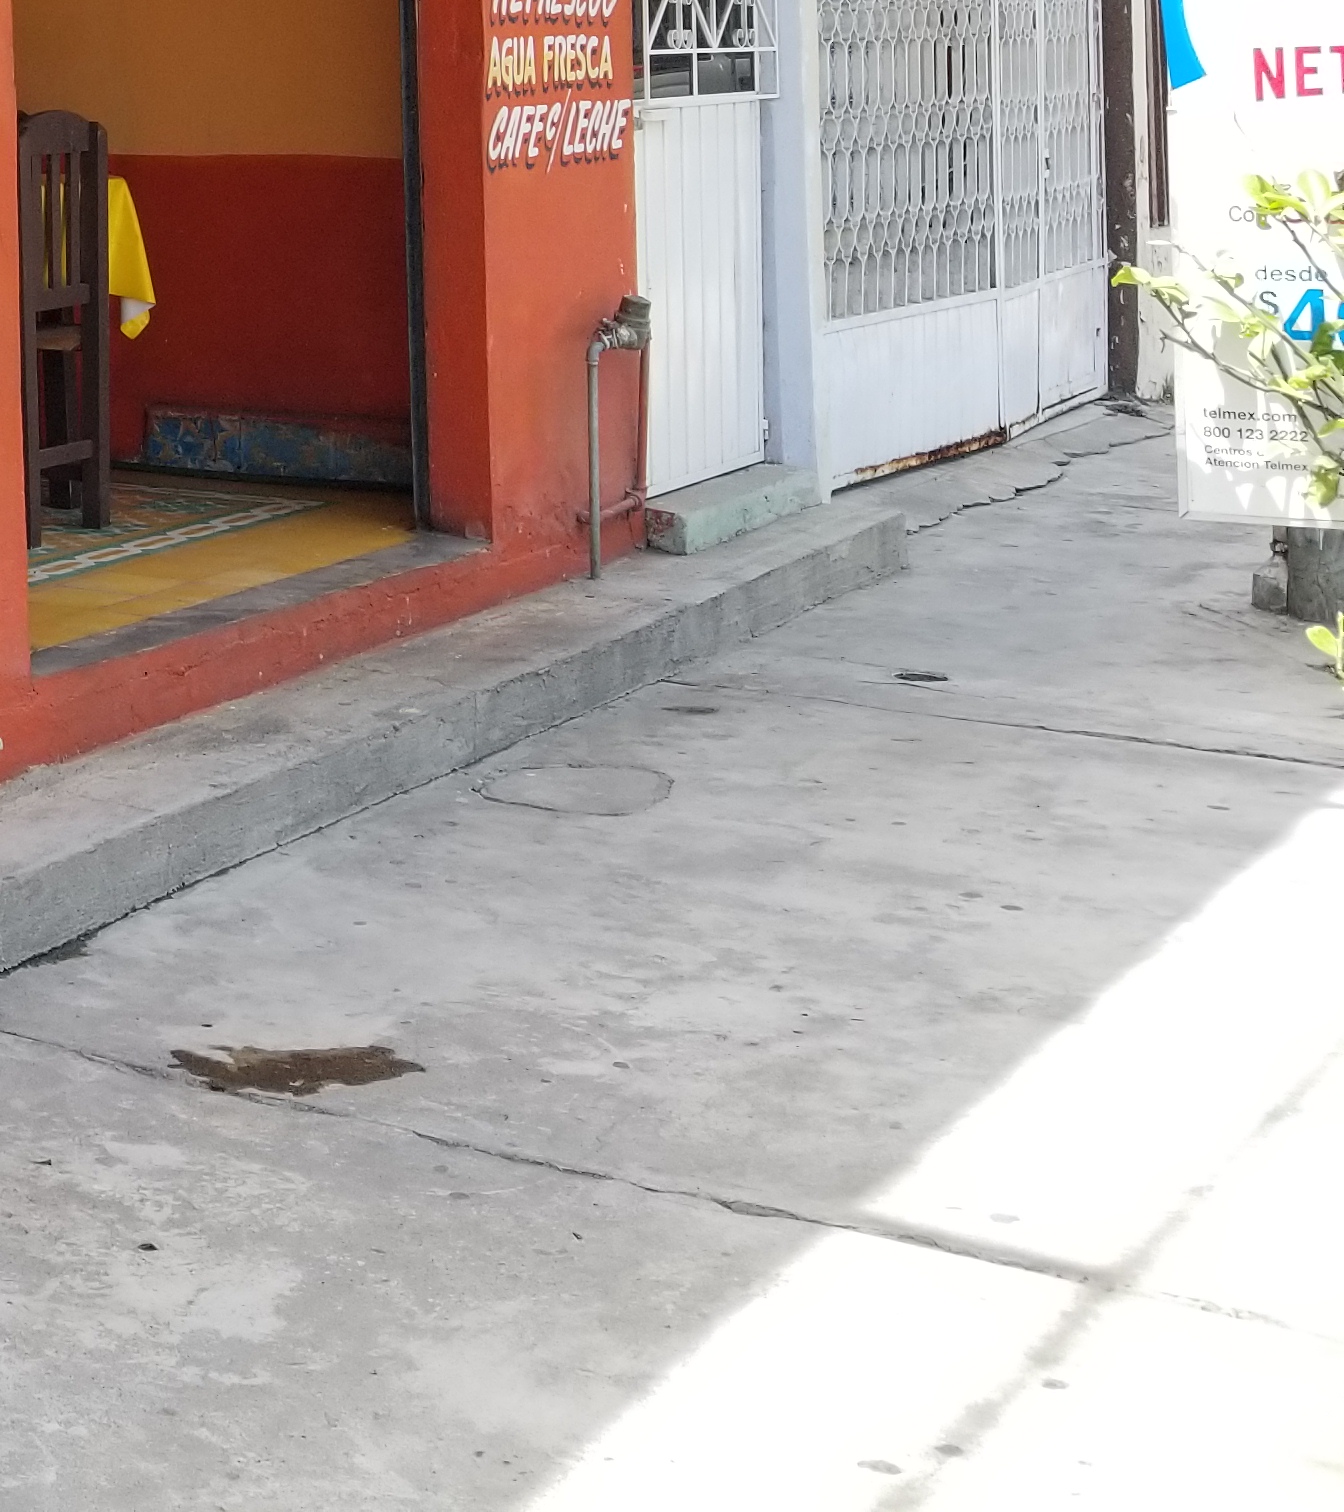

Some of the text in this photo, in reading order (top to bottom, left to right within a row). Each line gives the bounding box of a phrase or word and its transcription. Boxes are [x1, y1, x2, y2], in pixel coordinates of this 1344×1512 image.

[487, 34, 614, 94] AGUA FRESCA
[1203, 408, 1298, 423] telmex.com
[1203, 426, 1309, 442] 800 123 2222
[1264, 461, 1309, 472] Telmex
